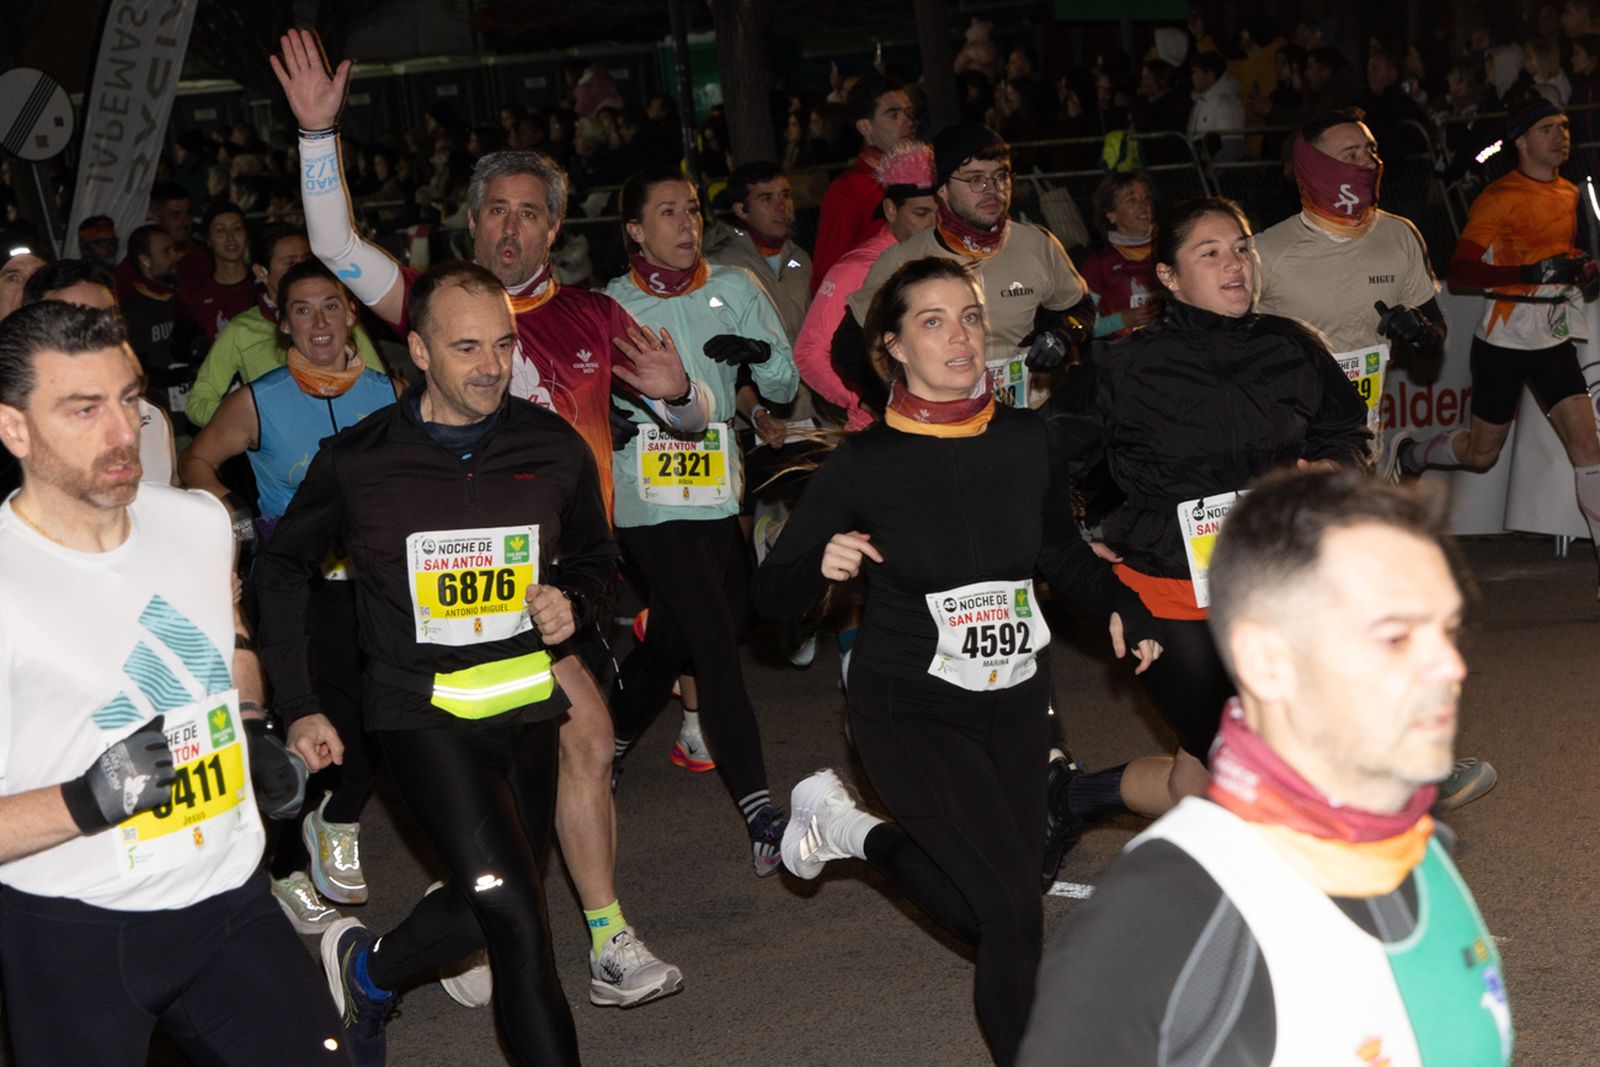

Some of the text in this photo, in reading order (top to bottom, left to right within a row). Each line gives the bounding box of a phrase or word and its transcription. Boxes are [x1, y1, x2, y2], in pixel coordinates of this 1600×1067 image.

[1000, 287, 1034, 298] CARLOS
[648, 443, 665, 451] SAN
[658, 452, 710, 477] 2321
[1196, 522, 1220, 535] SAN
[438, 542, 477, 555] NOCHE
[478, 541, 492, 552] DE
[424, 553, 493, 571] SAN ANTÓN
[437, 568, 515, 606] 6876
[960, 596, 994, 611] NOCHE
[996, 594, 1008, 605] DE
[445, 604, 509, 617] ANTONIO MIGUEL
[948, 612, 973, 627] SAN
[961, 621, 1033, 659] 4592
[983, 658, 1009, 667] MARINA
[183, 725, 198, 740] DE
[173, 742, 200, 764] TÓN
